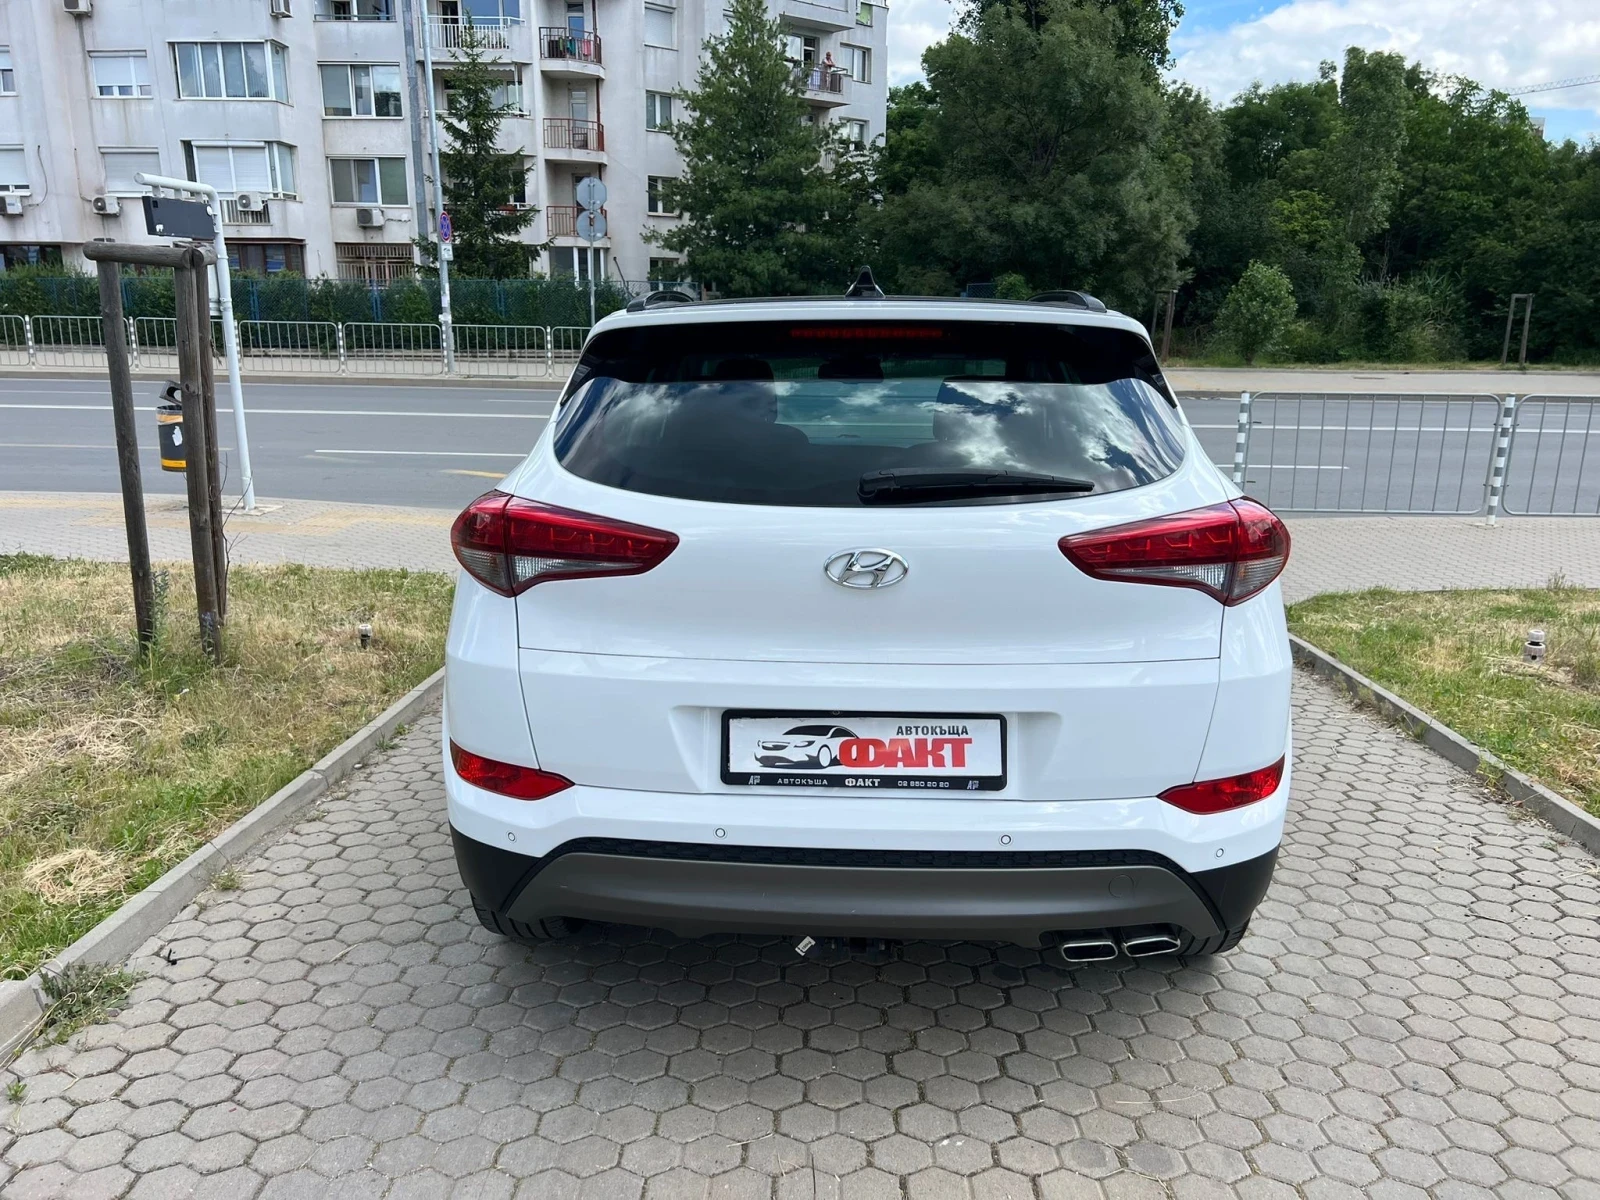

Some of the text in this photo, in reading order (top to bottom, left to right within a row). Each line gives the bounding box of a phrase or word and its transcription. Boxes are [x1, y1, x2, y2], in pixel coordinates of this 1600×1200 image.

[896, 725, 969, 737] АВТОКЪЩА
[839, 738, 972, 768] ФАКТ
[845, 778, 881, 787] ФАКТ
